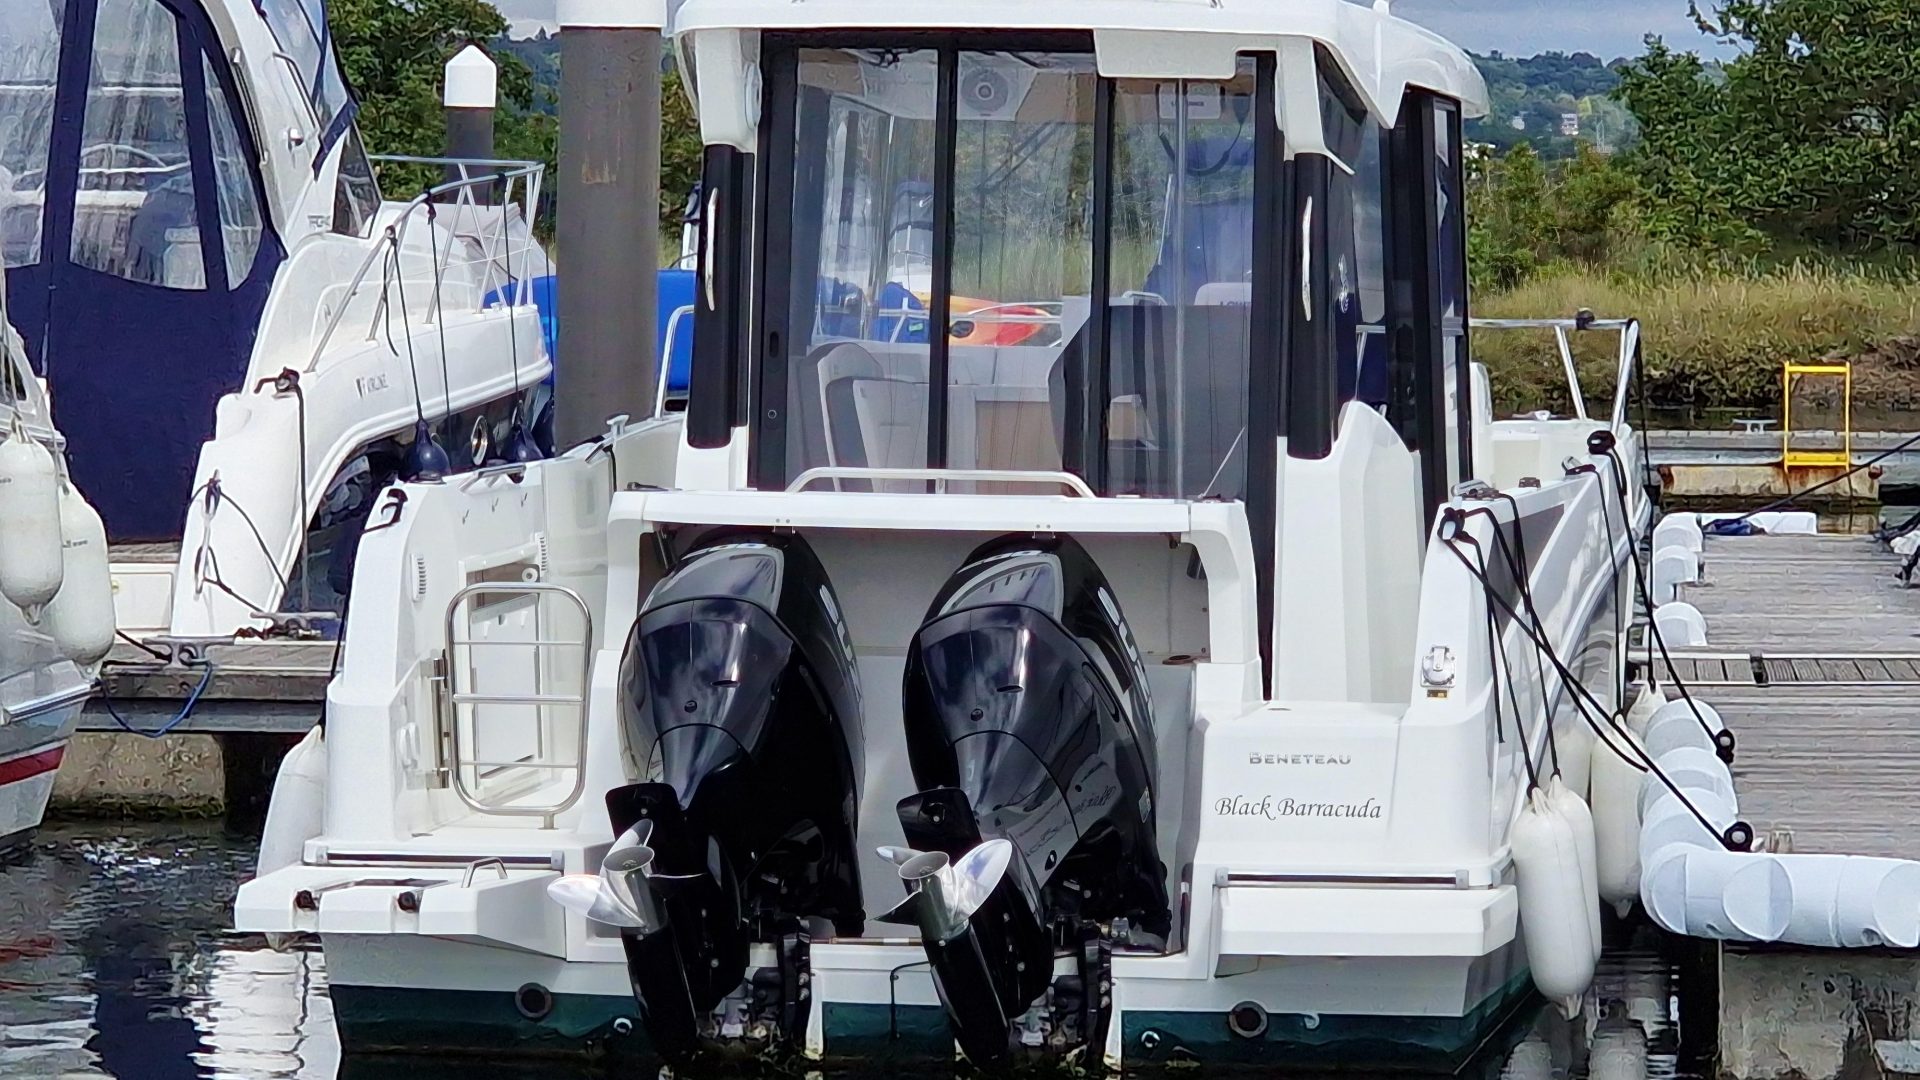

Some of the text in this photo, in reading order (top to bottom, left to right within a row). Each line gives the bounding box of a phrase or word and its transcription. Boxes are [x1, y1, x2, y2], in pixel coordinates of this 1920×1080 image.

[1249, 752, 1352, 765] BENETEAU
[1214, 795, 1382, 821] Black Barracuda
